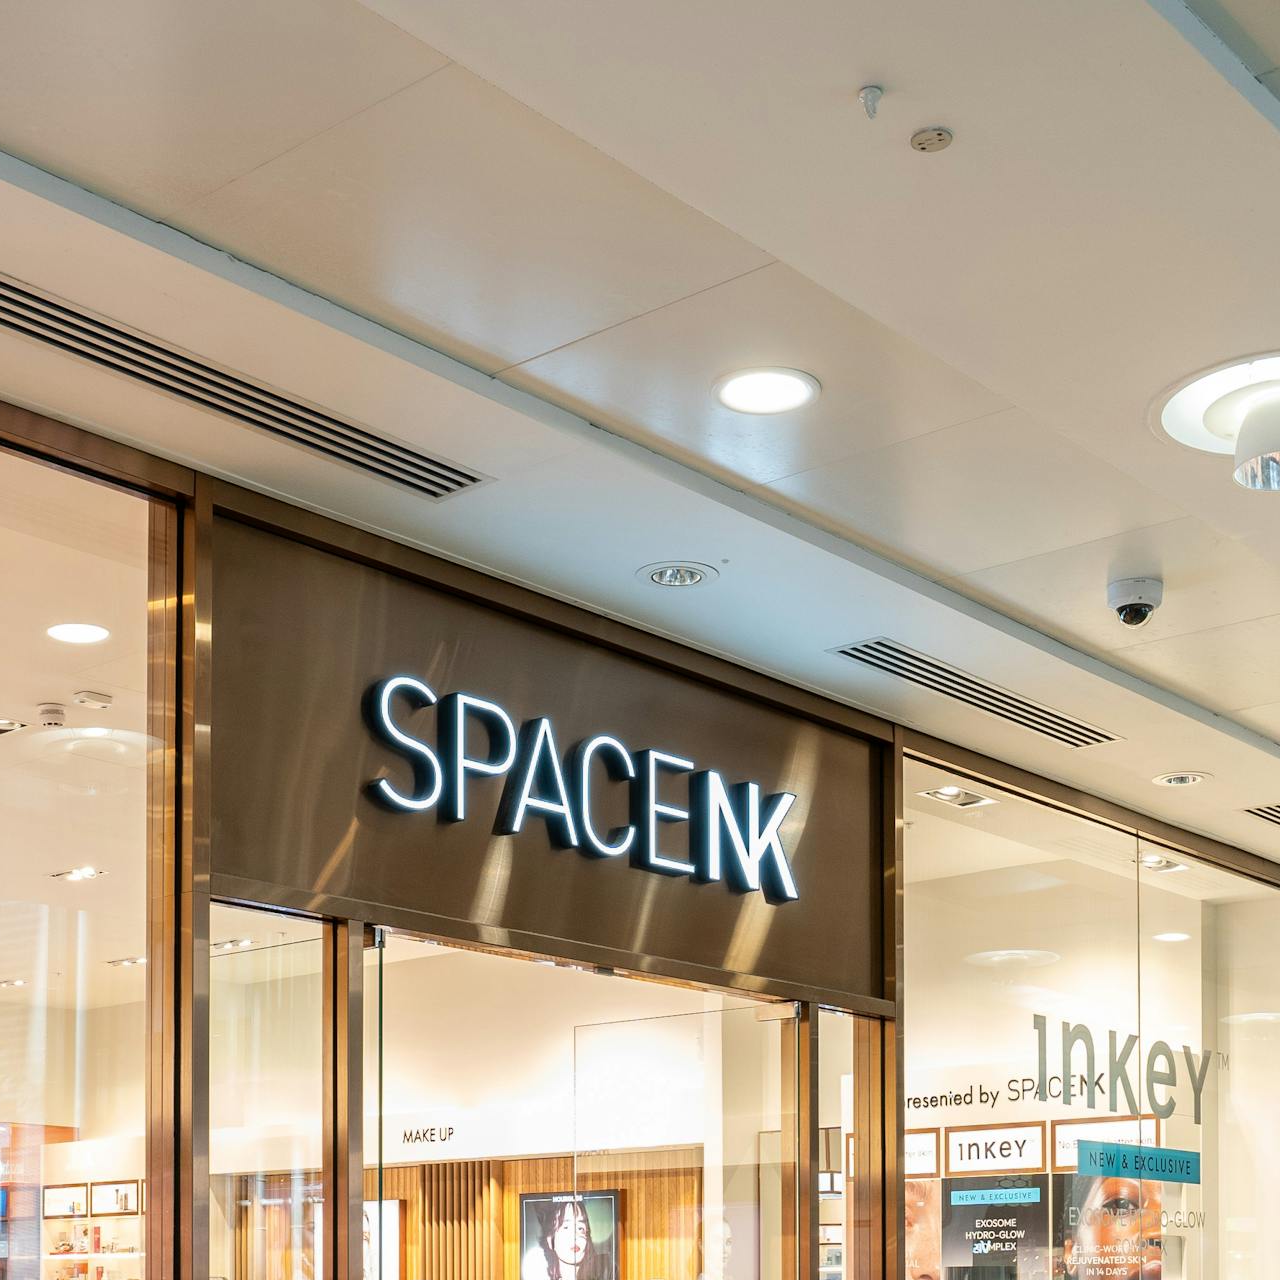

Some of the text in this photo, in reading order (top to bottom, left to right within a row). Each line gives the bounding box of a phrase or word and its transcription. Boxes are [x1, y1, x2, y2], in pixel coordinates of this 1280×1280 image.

[367, 676, 799, 902] SPACENK
[906, 1085, 973, 1109] resented
[979, 1085, 1000, 1109] by
[403, 1127, 454, 1143] MAKE UP
[1089, 1151, 1191, 1175] NEW & EXCLUSIVE
[959, 1194, 976, 1202] NEW
[989, 1192, 1032, 1200] EXCLUSIVE
[975, 1218, 1017, 1228] EXOSOME
[1130, 1208, 1206, 1229] HYO-GLOW
[965, 1230, 1026, 1240] HYDRO-GLOW
[974, 1241, 1017, 1252] MPLEX
[1067, 1255, 1147, 1265] REJUVENATED SKIN
[1086, 1268, 1095, 1276] IN
[1105, 1267, 1128, 1276] DAYS
